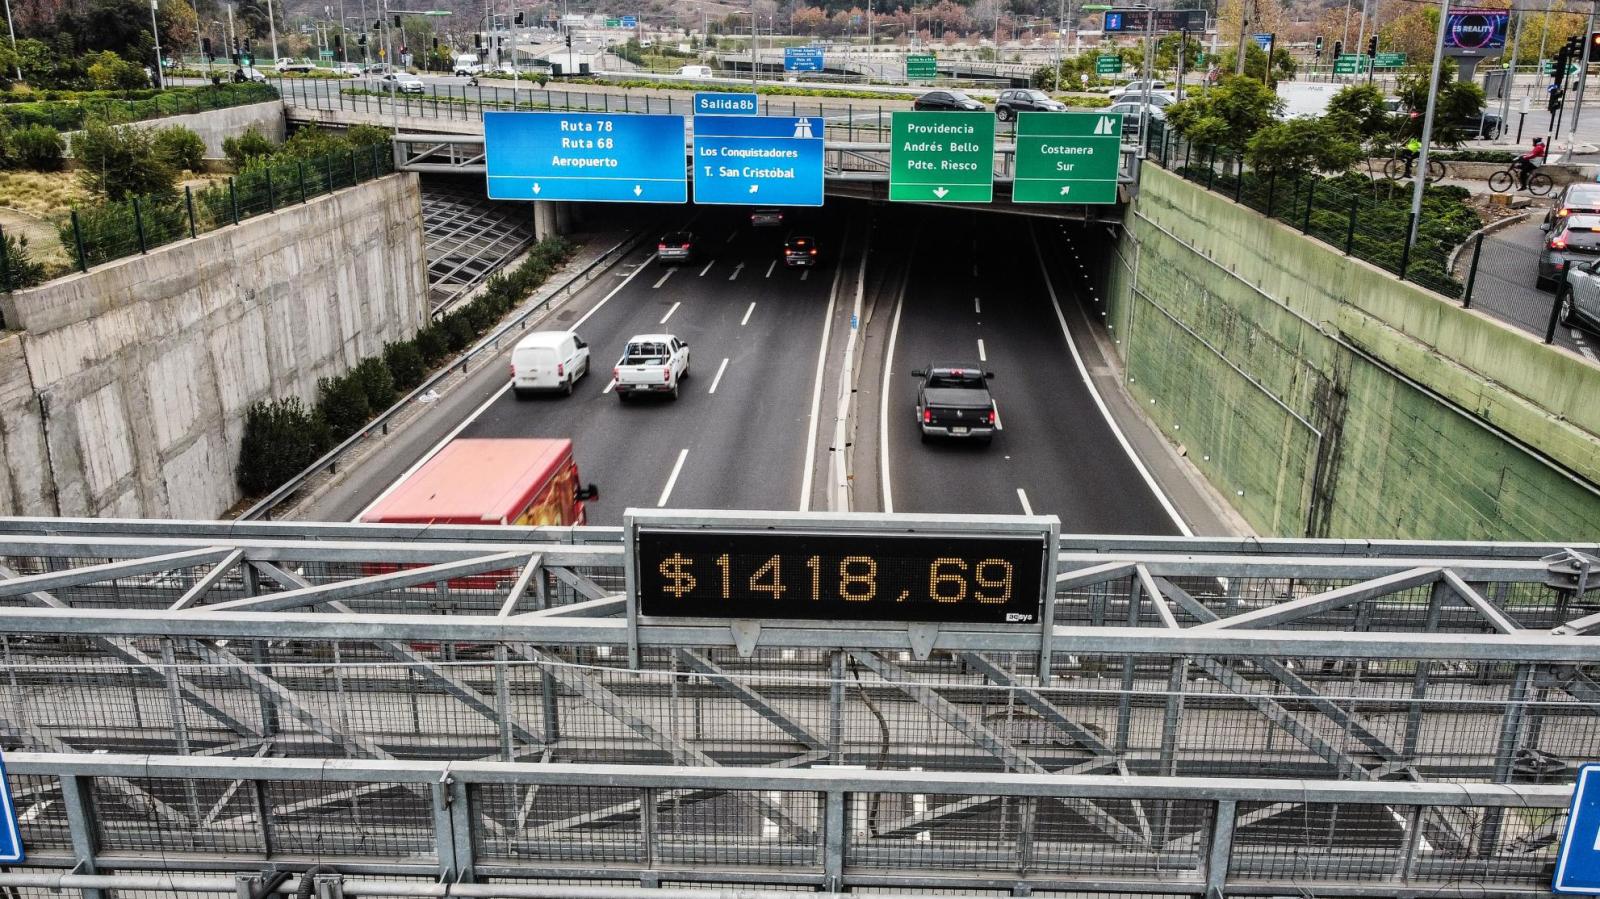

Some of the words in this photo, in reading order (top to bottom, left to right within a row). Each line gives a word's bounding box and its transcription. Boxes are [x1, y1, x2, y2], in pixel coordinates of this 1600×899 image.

[1452, 25, 1462, 33] ES
[1463, 25, 1494, 33] REALITY
[700, 98, 754, 111] Salida8b
[560, 120, 592, 132] Ruta
[596, 120, 613, 132] 78
[907, 123, 974, 134] Providencia
[561, 137, 593, 149] Ruta
[597, 138, 614, 149] 68
[903, 141, 943, 152] Andrés
[950, 142, 979, 152] Bello
[700, 147, 718, 157] Los
[721, 147, 798, 159] Conquistadores
[1040, 144, 1094, 155] Costanera
[552, 156, 618, 169] Aeropuerto
[907, 160, 937, 170] Pdte.
[941, 160, 978, 170] Riesco
[1056, 161, 1075, 171] Sur
[704, 166, 713, 177] T.
[719, 167, 740, 177] San
[742, 166, 795, 179] Cristóbal
